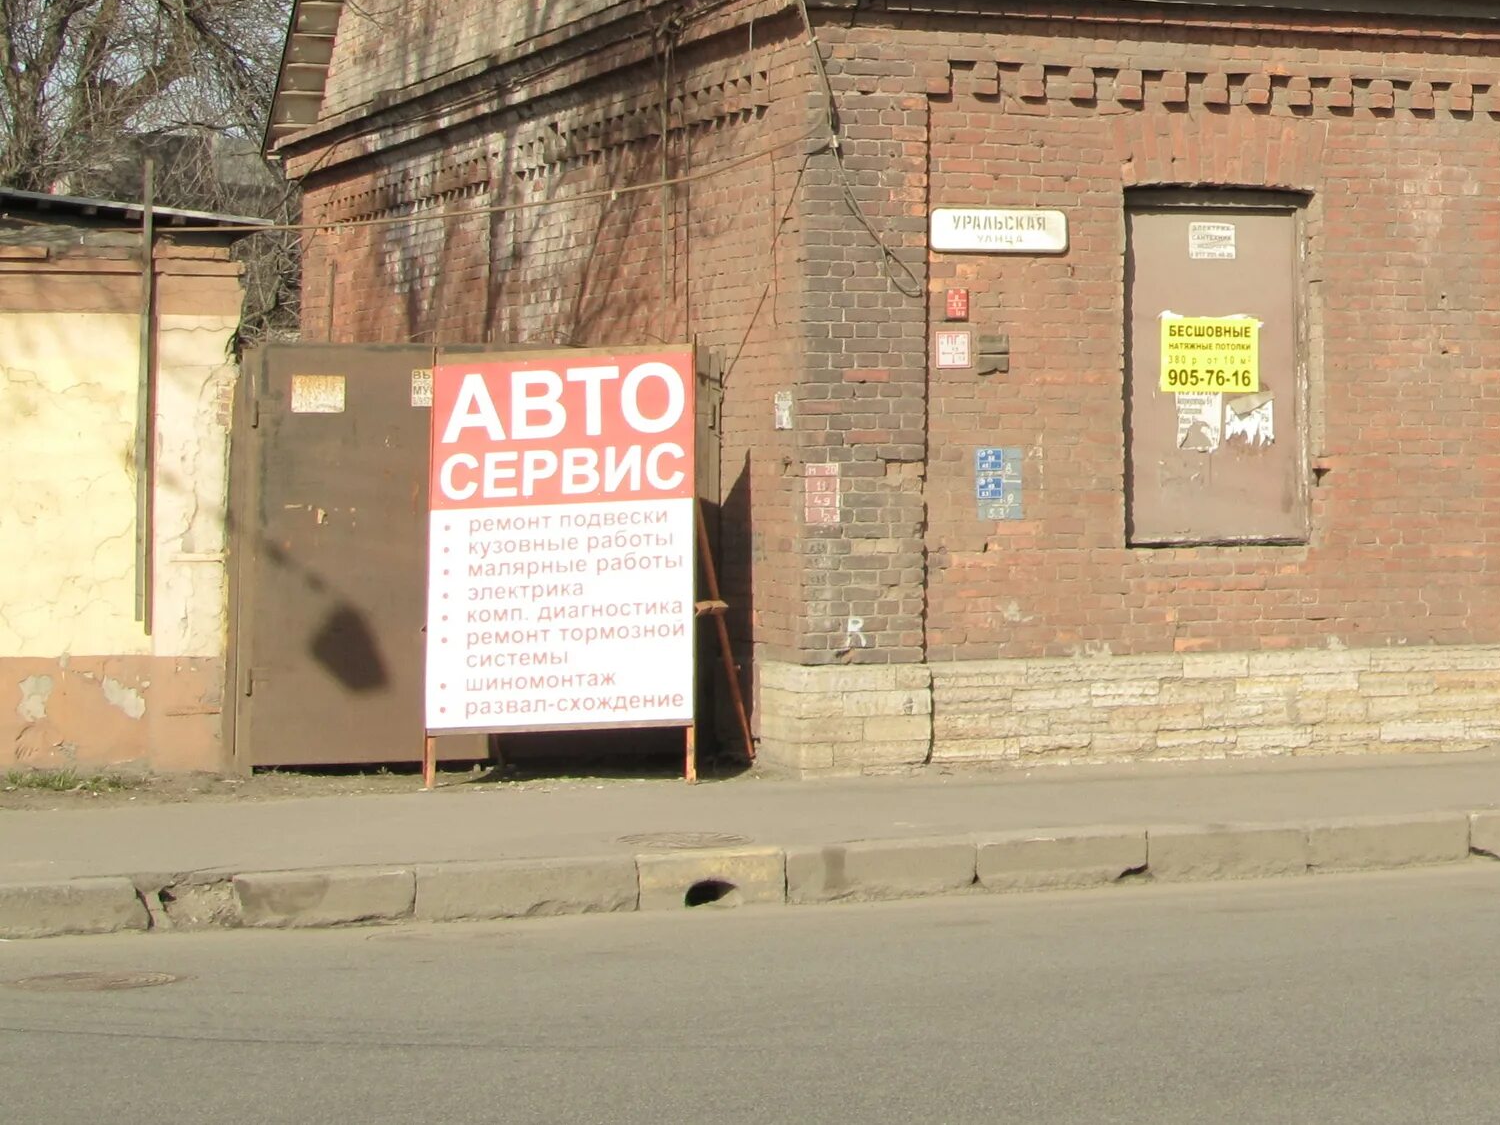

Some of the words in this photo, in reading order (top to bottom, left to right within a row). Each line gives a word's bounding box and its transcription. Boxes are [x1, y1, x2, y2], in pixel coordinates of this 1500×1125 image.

[952, 215, 1047, 231] УРАЛЬСКАЯ
[976, 234, 1024, 245] УЛИЦА
[1169, 325, 1251, 337] БЕСШОВНЫЕ
[1168, 342, 1213, 350] НАТЯЖНЫЕ
[1168, 369, 1251, 386] 905-76-16
[441, 362, 685, 443] АВТО
[440, 442, 685, 500] СЕРВИС
[469, 514, 552, 535] ремонт
[560, 510, 668, 528] подвески
[469, 536, 579, 558] кузовные
[587, 530, 673, 552] работы
[468, 558, 587, 577] малярные
[596, 552, 683, 575] работы
[467, 582, 584, 602] электрика
[467, 607, 529, 623] комп.
[537, 600, 683, 623] диагностика
[466, 628, 551, 649] ремонт
[559, 620, 685, 645] тормозной
[466, 651, 569, 668] системы
[466, 672, 616, 692] шиномонтаж
[465, 693, 684, 719] развал-схождение
